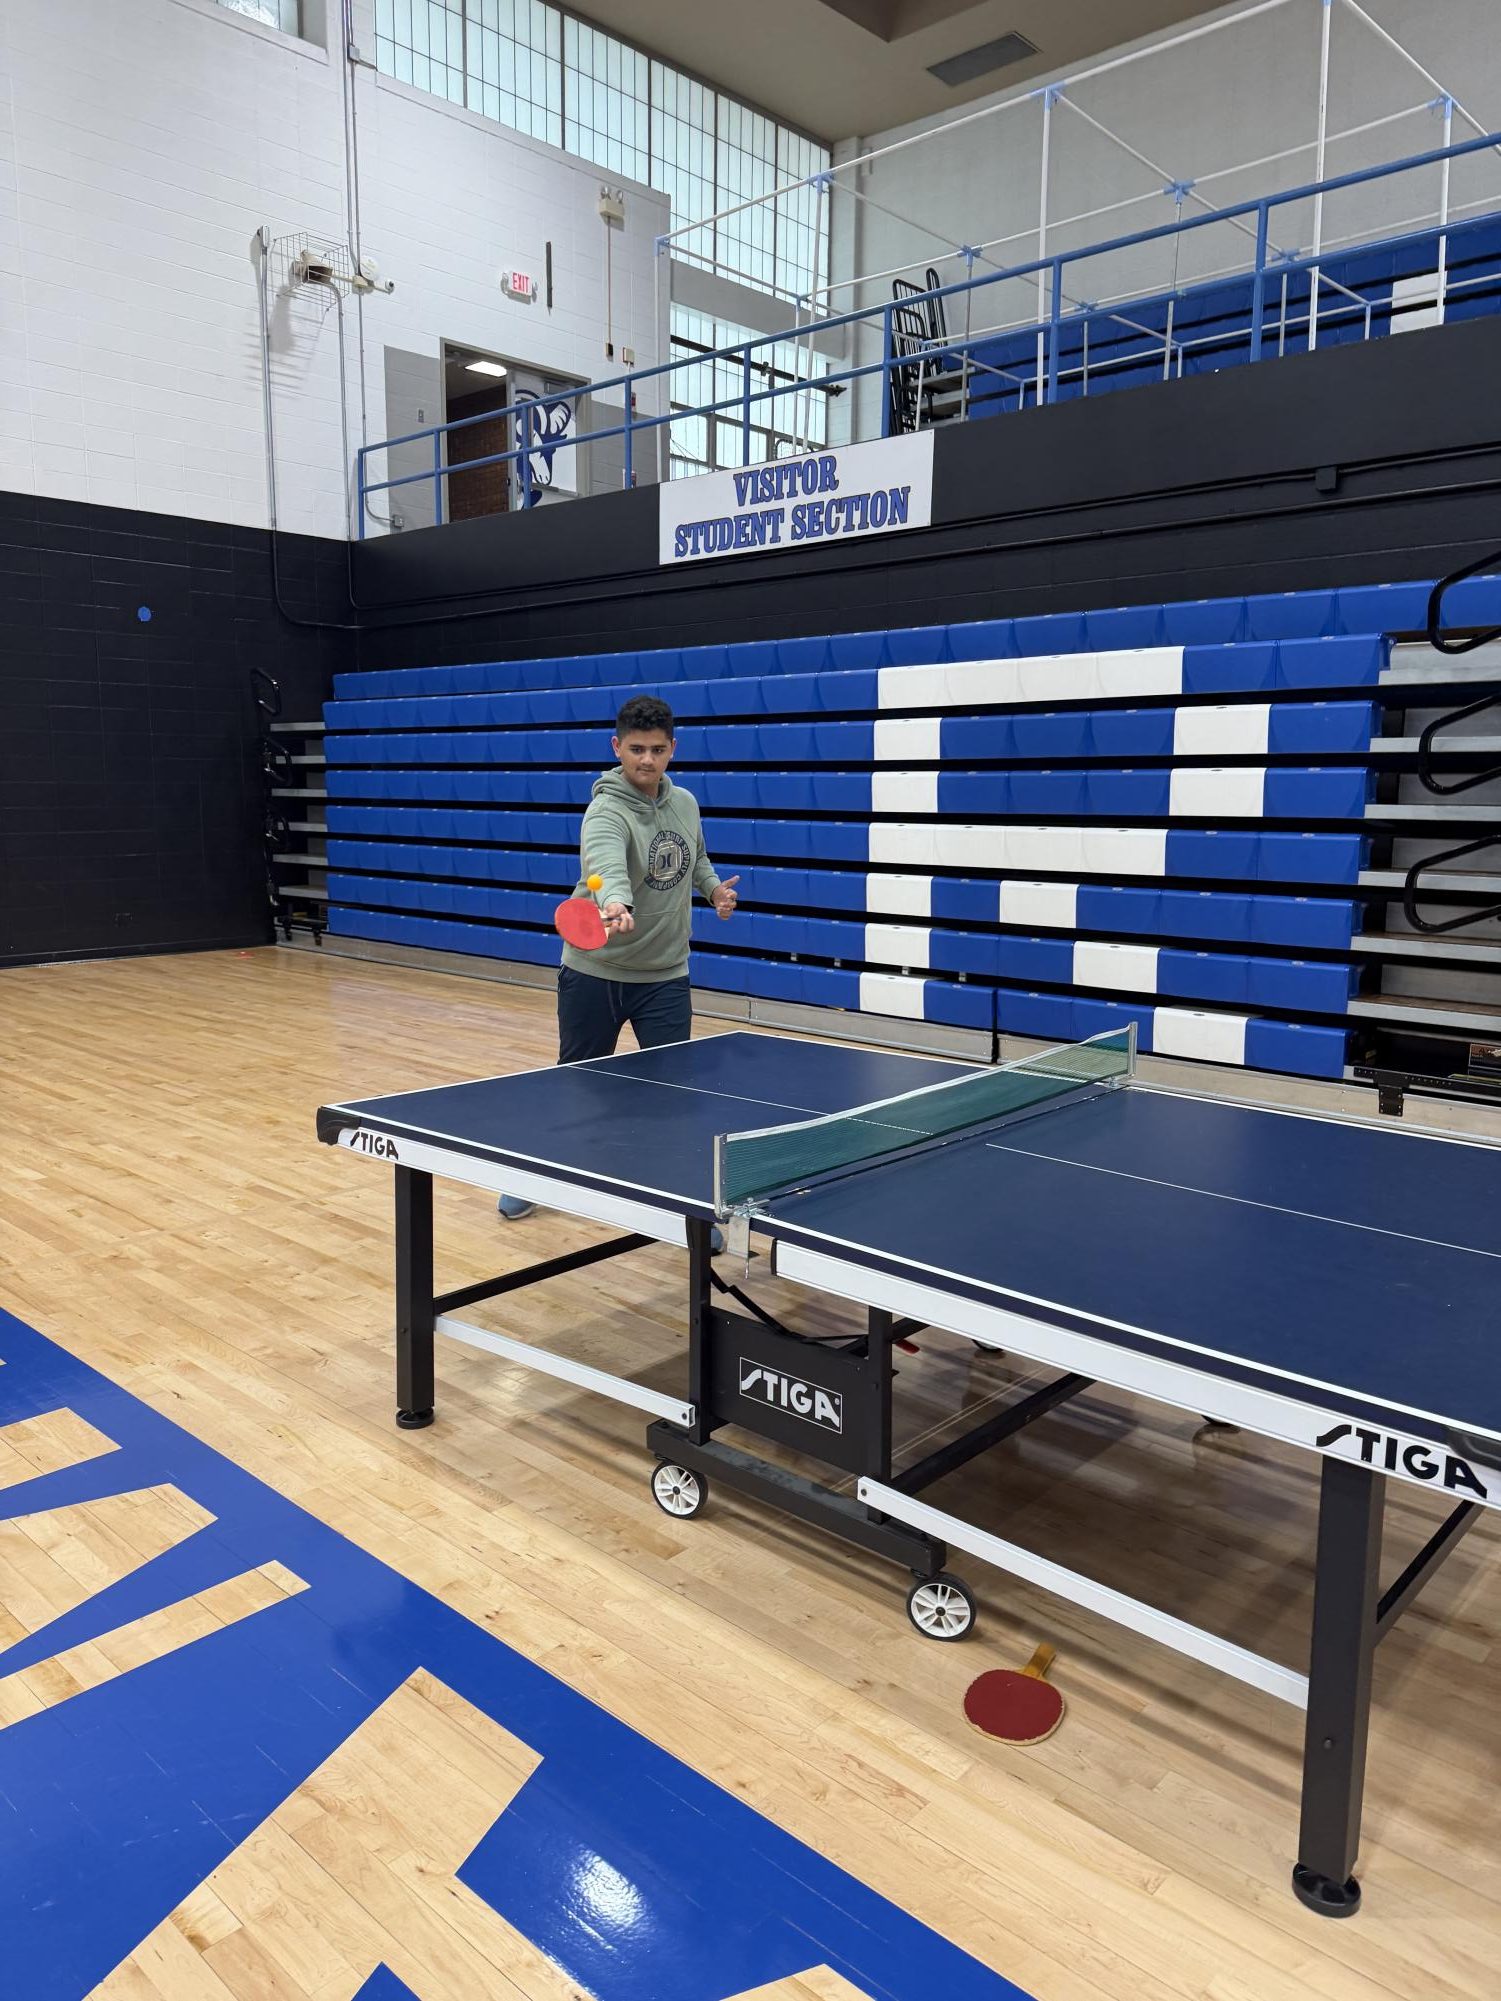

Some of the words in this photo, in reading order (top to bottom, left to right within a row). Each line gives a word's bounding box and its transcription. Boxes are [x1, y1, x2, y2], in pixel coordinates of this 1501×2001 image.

[512, 272, 530, 293] EXIT
[733, 455, 839, 507] VISITOR
[674, 507, 785, 558] STUDENT
[791, 486, 911, 541] SECTION
[350, 1131, 399, 1160] STIGA
[741, 1369, 840, 1428] STIGA
[1316, 1424, 1488, 1499] STIGA
